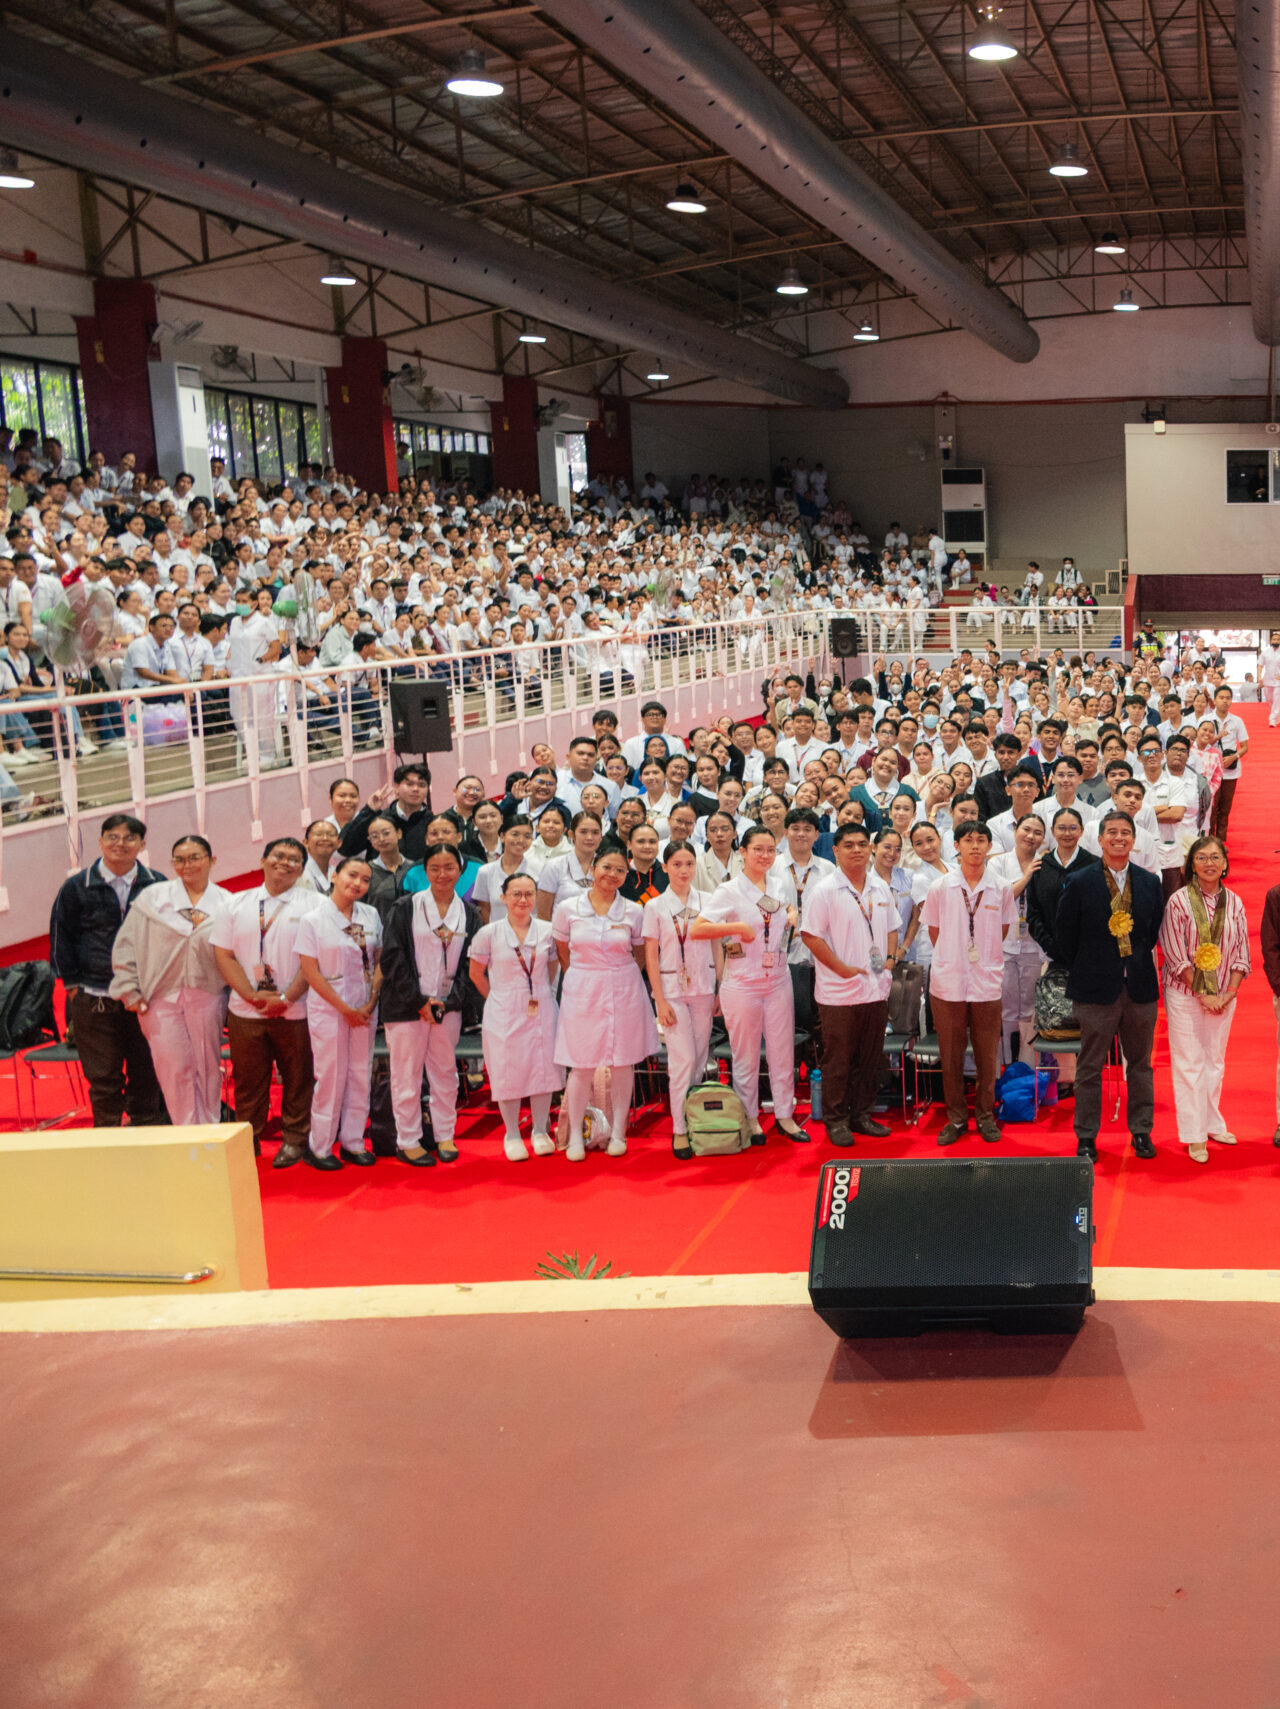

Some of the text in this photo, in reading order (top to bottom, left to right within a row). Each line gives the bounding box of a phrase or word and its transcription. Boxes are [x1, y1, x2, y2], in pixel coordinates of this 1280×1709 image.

[1263, 577, 1280, 586] EXIT
[851, 1168, 860, 1187] TS312
[829, 1170, 850, 1230] 2000
